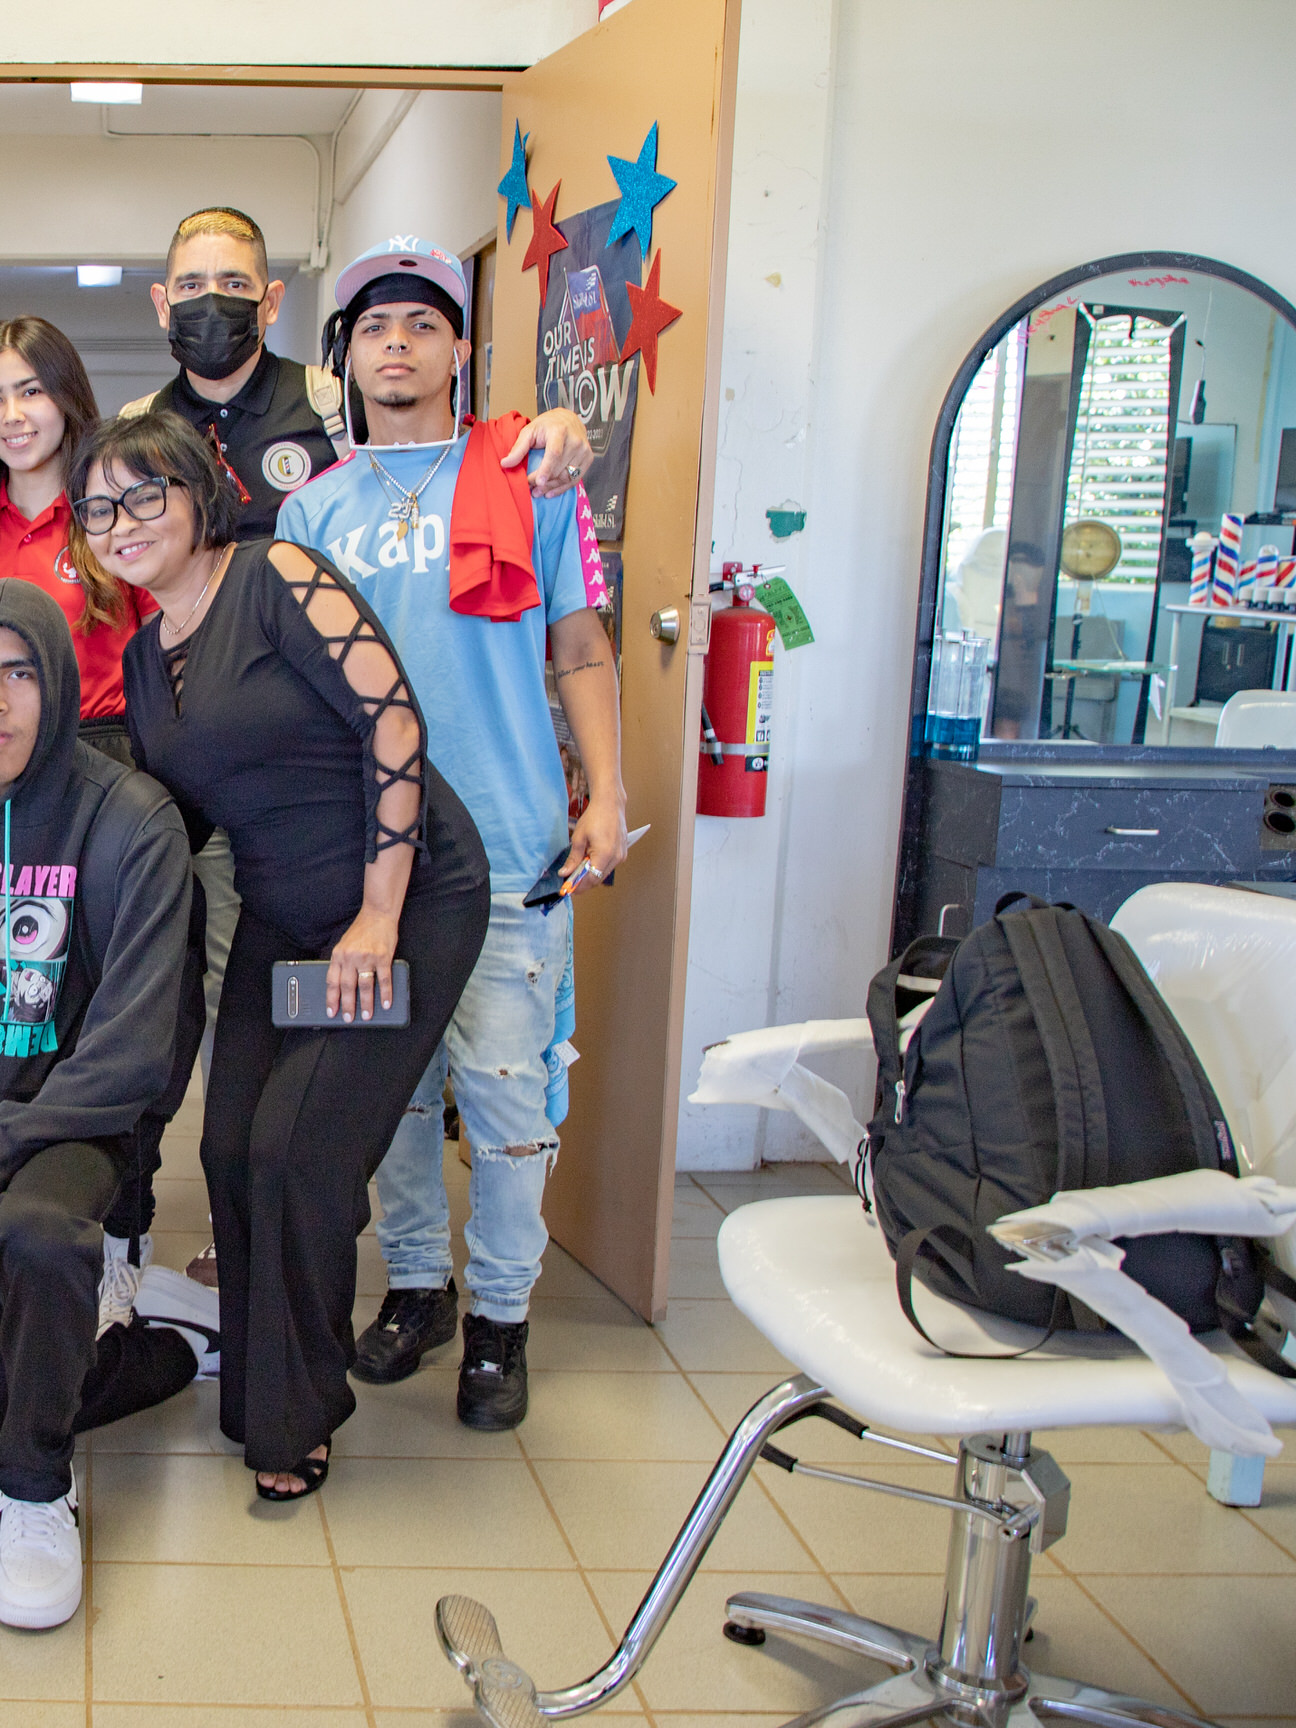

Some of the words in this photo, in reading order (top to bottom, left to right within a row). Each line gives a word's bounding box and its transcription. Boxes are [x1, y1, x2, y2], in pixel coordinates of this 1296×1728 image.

[543, 320, 572, 356] OUR
[548, 344, 581, 381] TIME
[584, 336, 595, 366] IS
[557, 359, 635, 425] NOW
[326, 513, 451, 585] Kap
